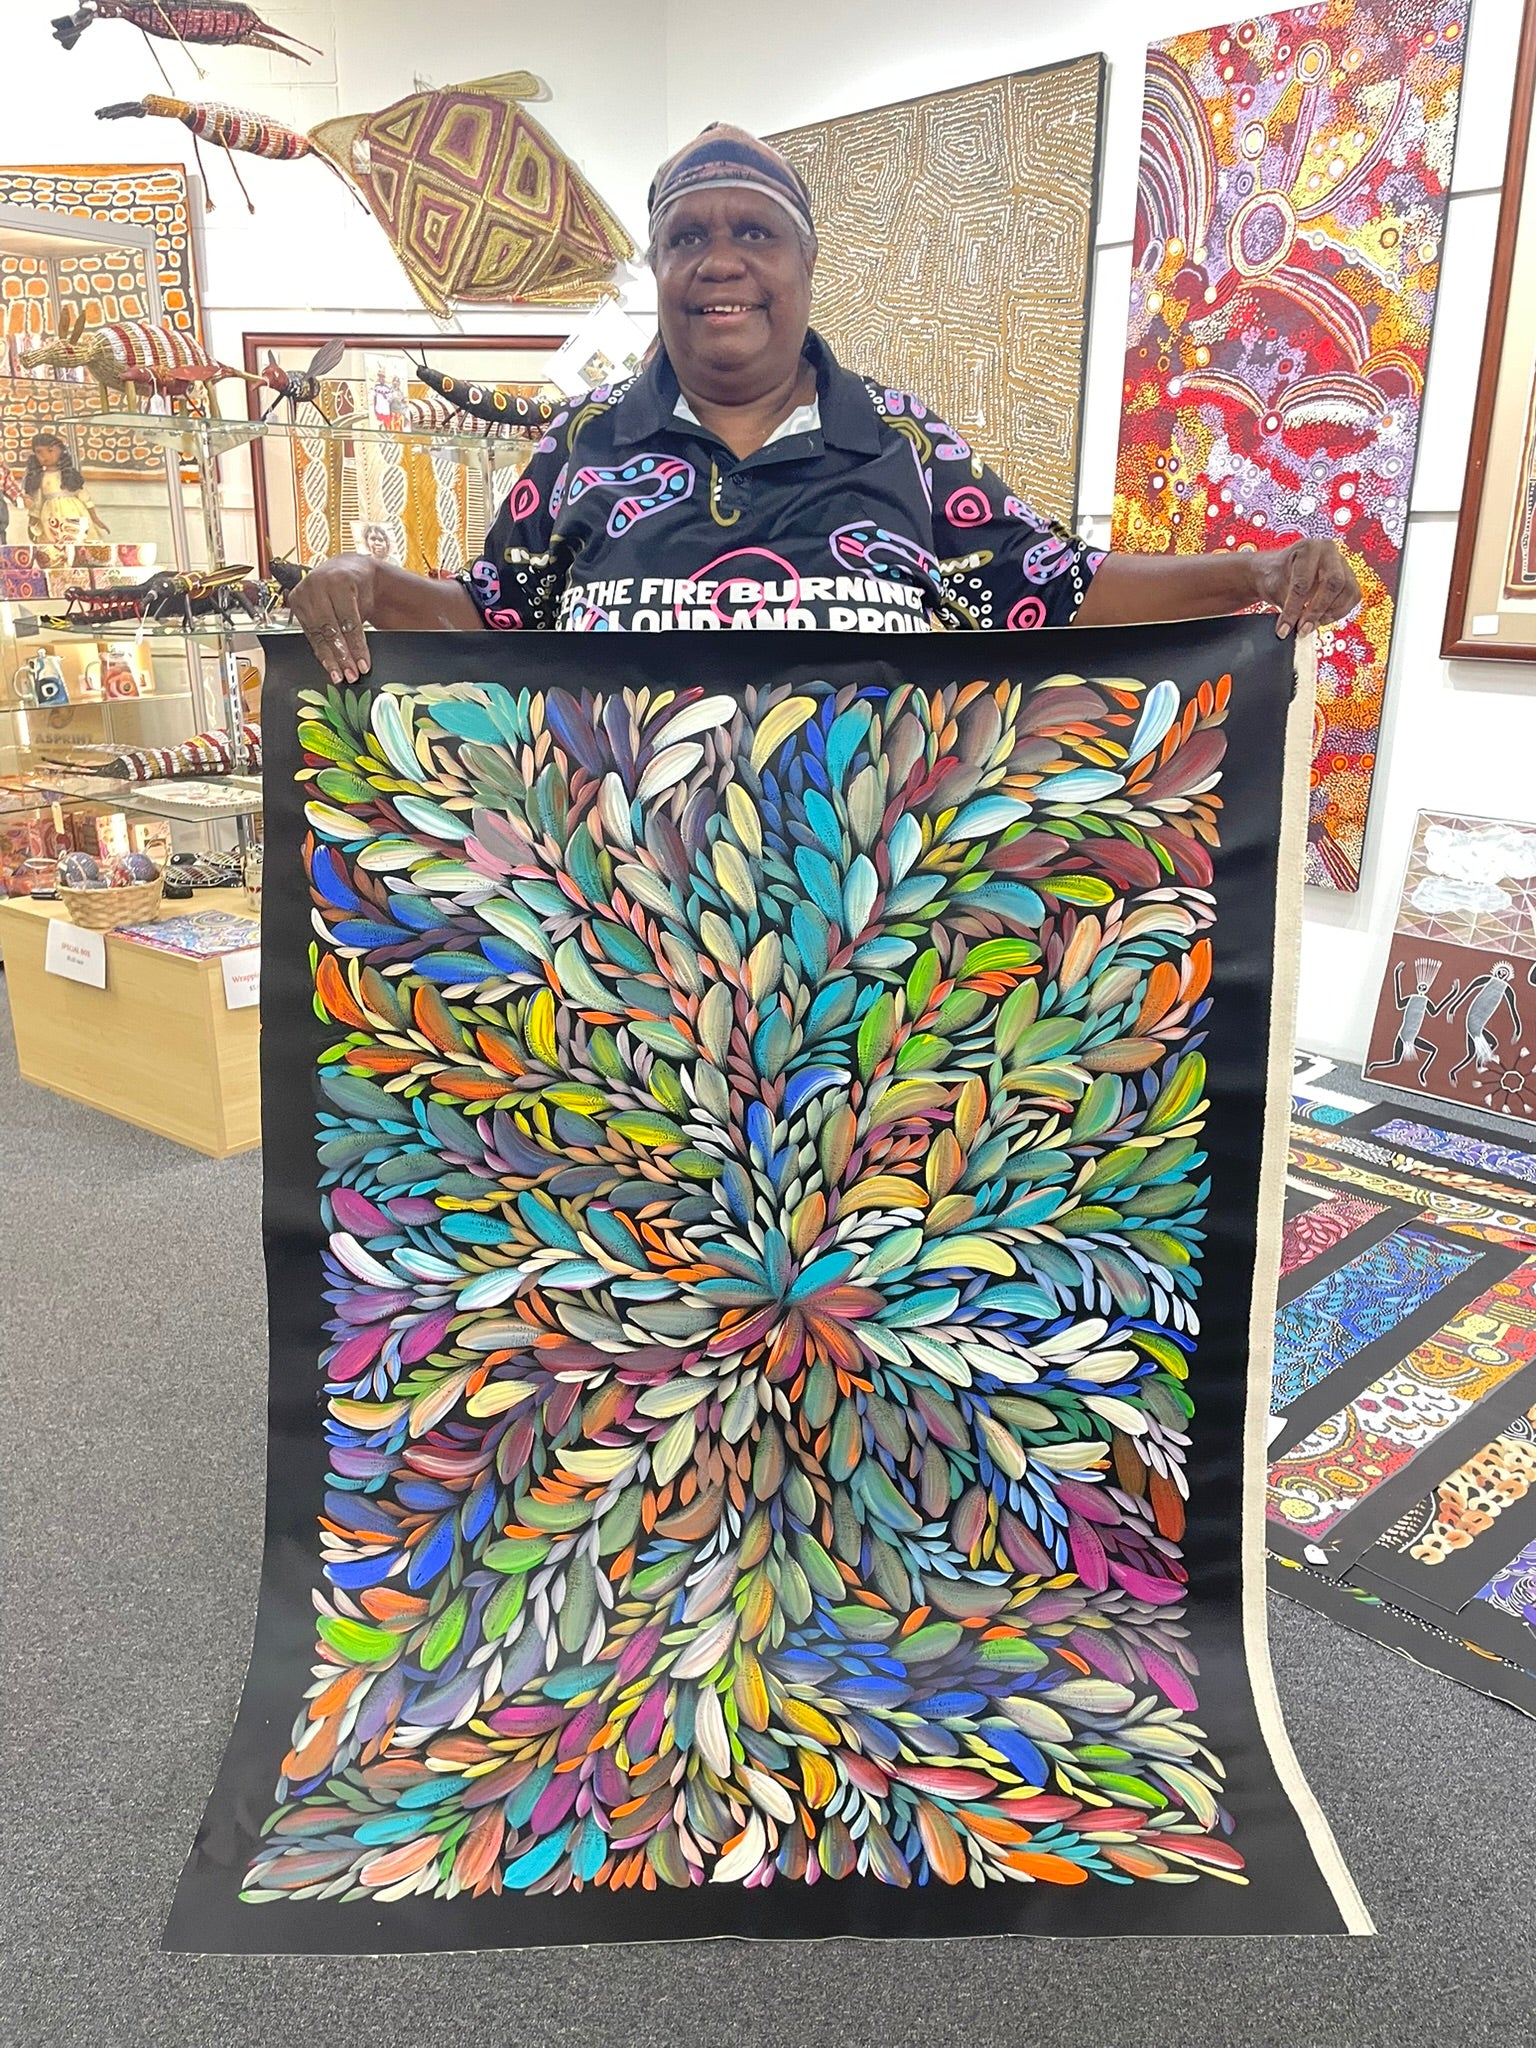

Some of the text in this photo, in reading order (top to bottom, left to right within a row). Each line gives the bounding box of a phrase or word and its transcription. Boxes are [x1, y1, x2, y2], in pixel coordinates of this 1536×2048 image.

[586, 578, 635, 608] THE
[640, 578, 719, 604] FIRE
[731, 607, 817, 631] AND
